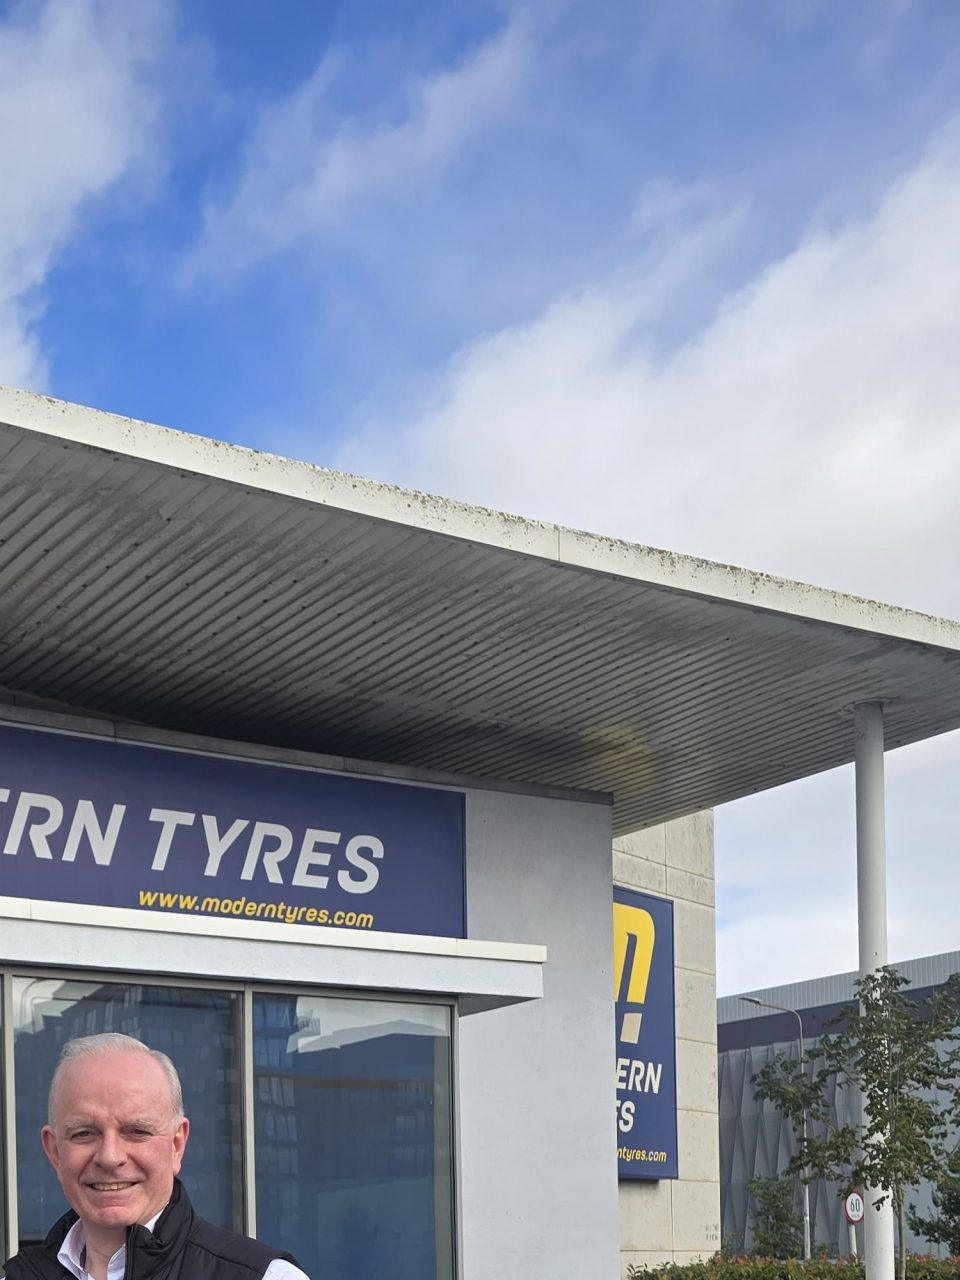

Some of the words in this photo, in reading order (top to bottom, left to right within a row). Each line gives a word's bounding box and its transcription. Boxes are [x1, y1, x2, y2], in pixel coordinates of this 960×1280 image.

[148, 808, 385, 894] TYRES
[139, 890, 374, 929] www.moderntyres.com
[616, 1057, 662, 1094] ERN
[617, 1146, 667, 1163] ntyres.com
[850, 1198, 861, 1213] 60
